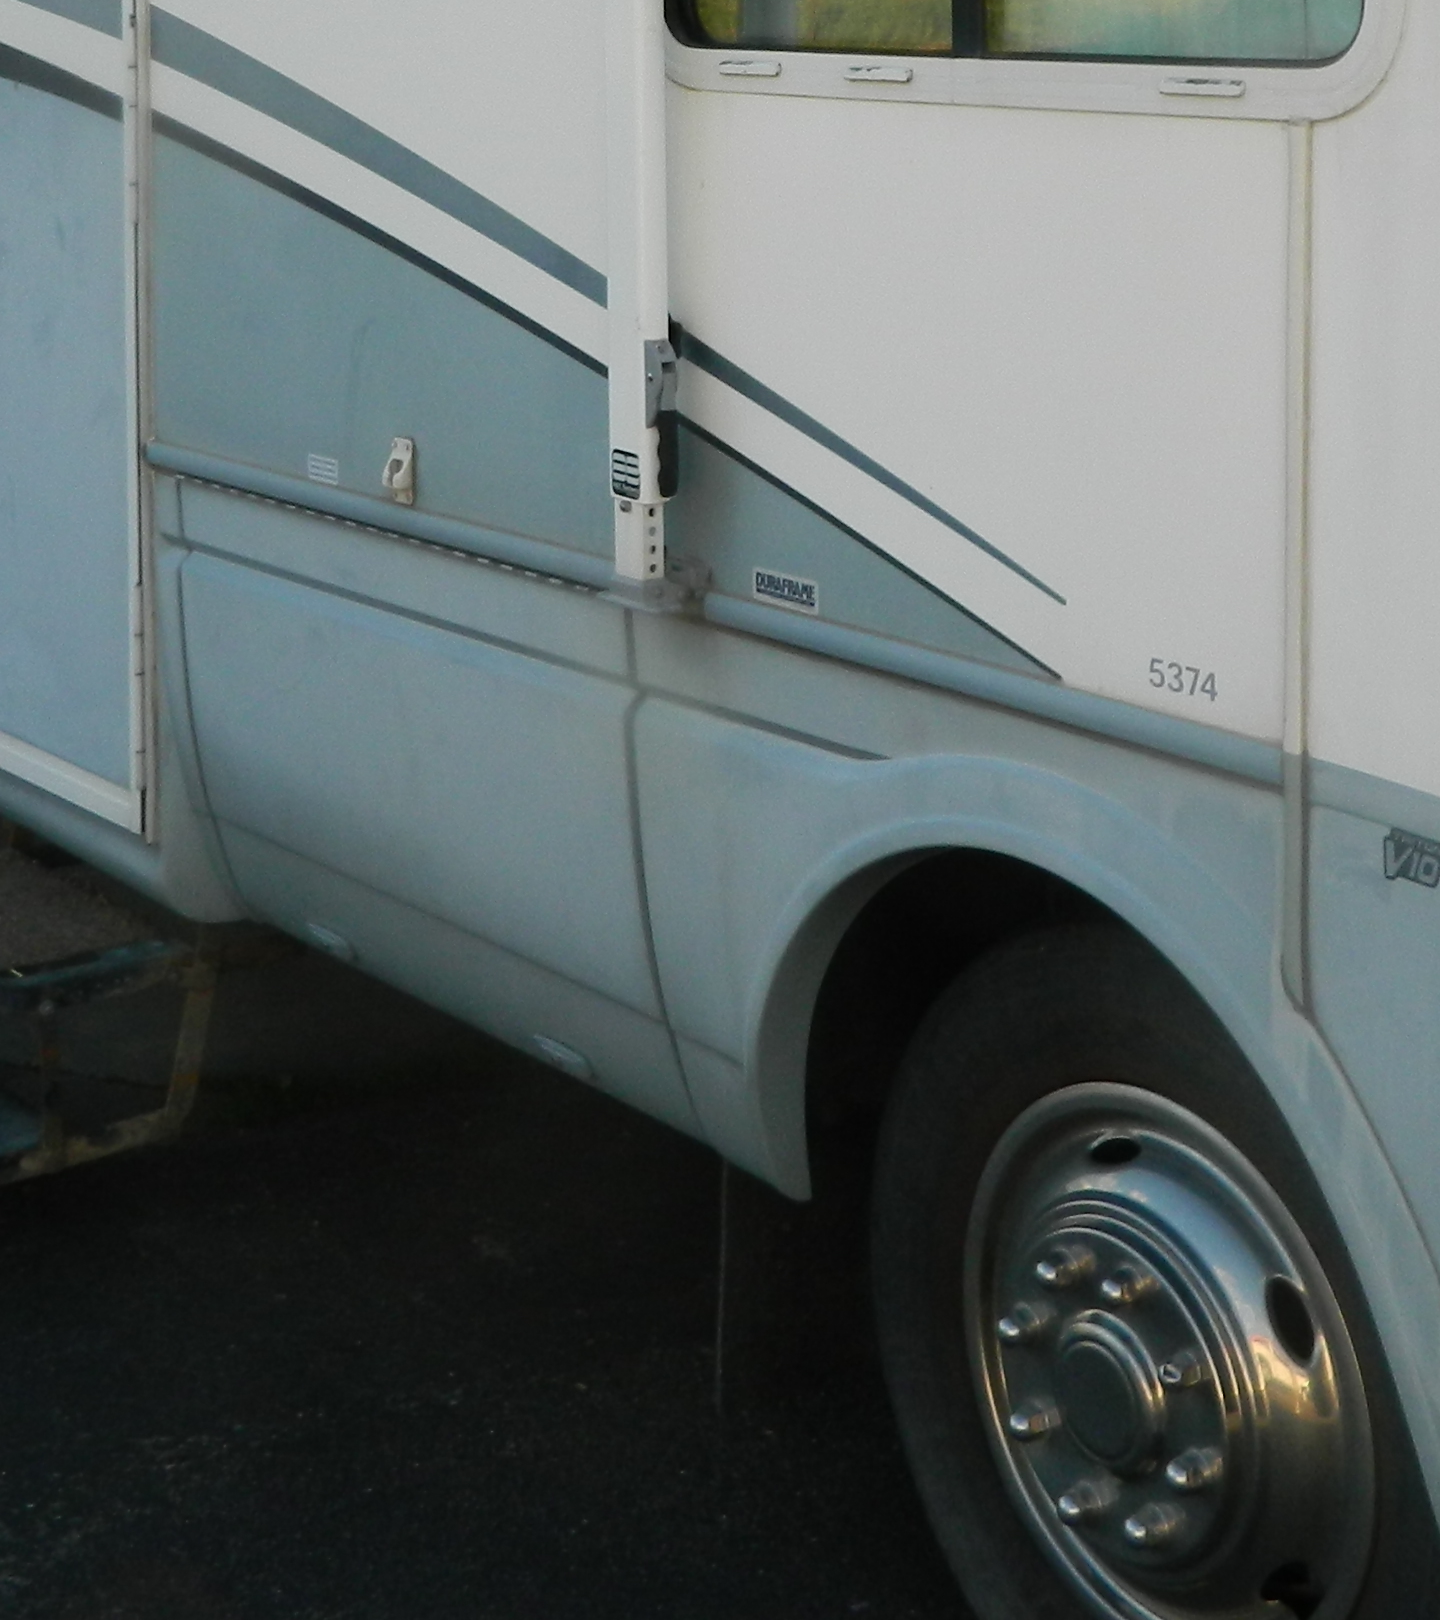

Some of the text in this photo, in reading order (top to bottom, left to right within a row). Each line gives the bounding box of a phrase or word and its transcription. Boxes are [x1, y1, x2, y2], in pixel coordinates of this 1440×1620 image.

[756, 571, 815, 600] DURAFRAME
[1149, 657, 1218, 701] 5374
[1385, 839, 1440, 886] V10
